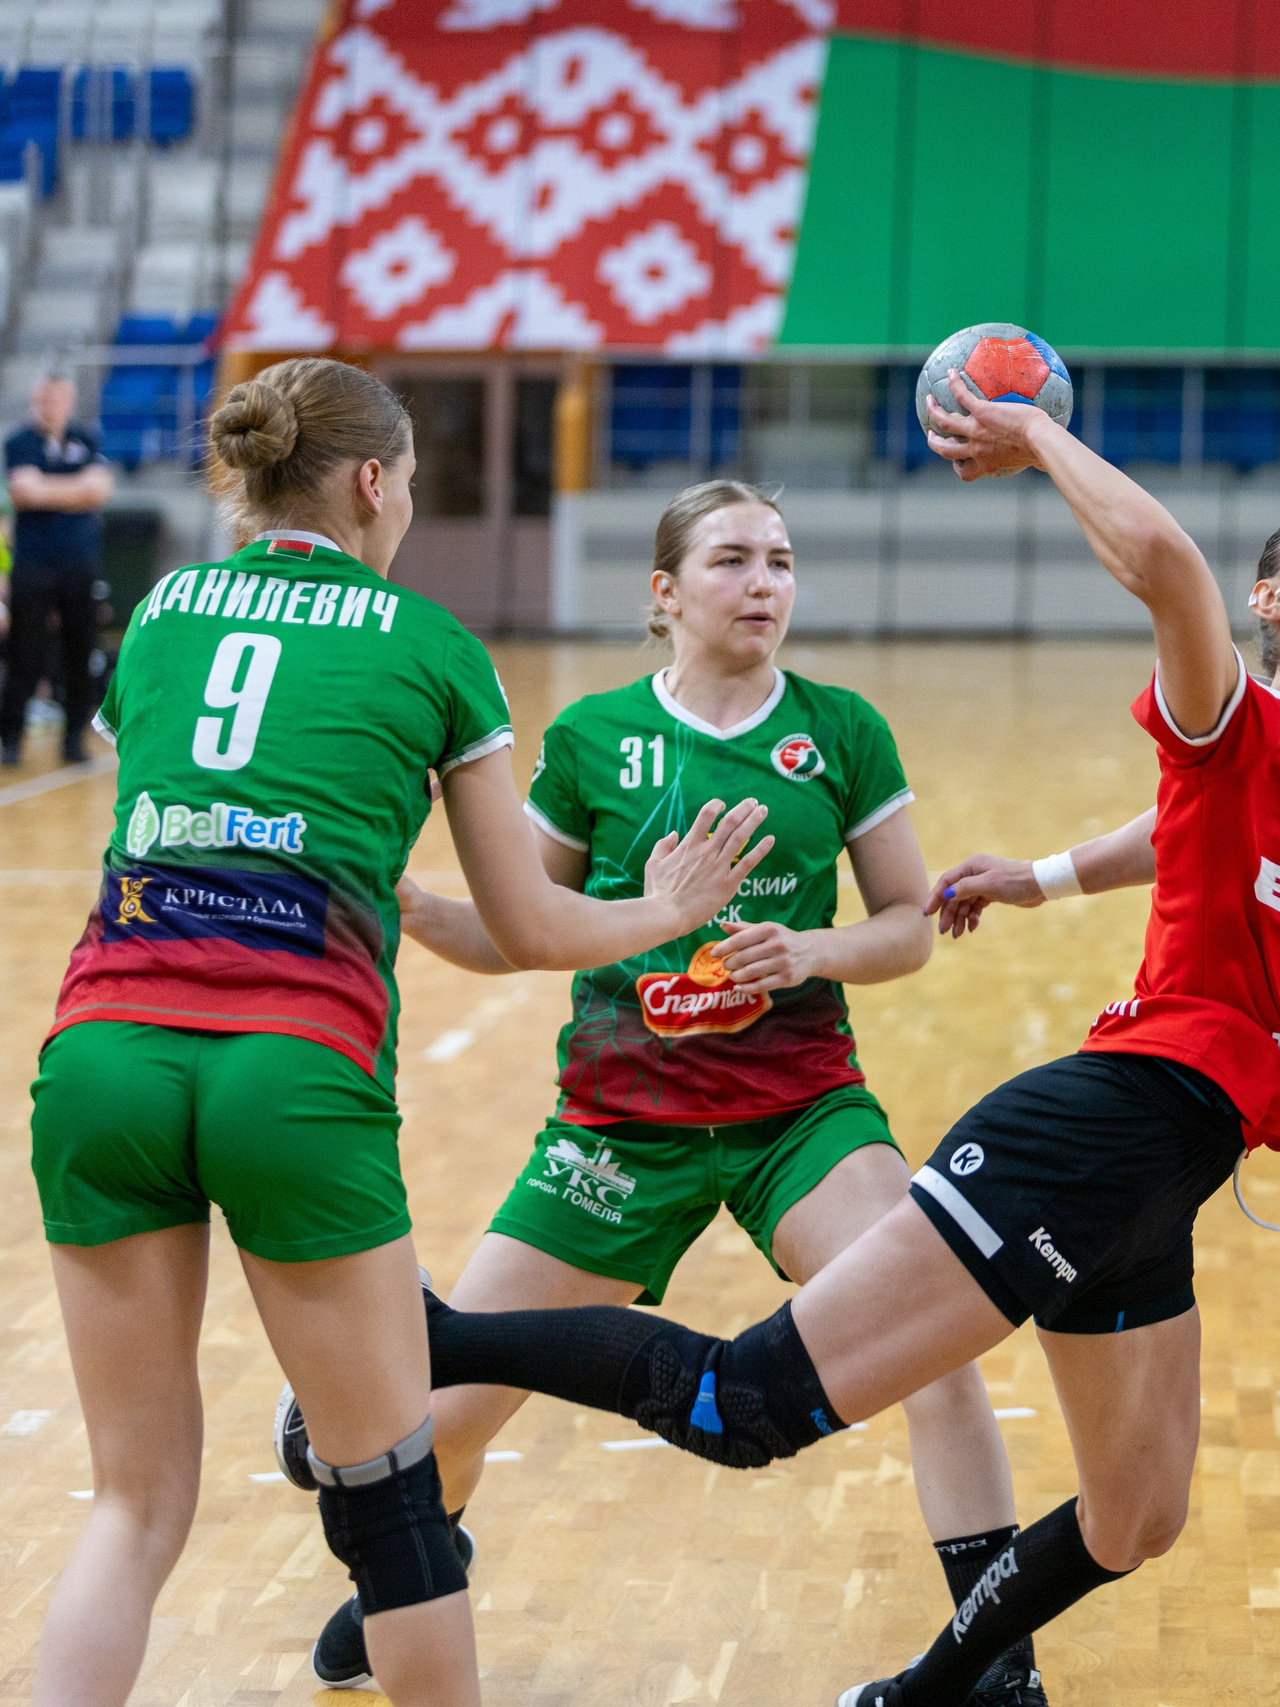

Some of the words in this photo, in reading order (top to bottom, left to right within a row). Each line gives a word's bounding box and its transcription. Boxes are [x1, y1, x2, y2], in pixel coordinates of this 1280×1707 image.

[140, 569, 399, 633] ДАНИЛЕВИЧ
[192, 632, 282, 771] 9
[620, 734, 664, 789] 31
[163, 806, 303, 850] BelFert
[526, 1178, 558, 1195] ГОРОДА
[562, 1187, 623, 1225] ГОМЕЛЯ
[1028, 1226, 1078, 1283] Kempa
[952, 1546, 1019, 1644] Kempa
